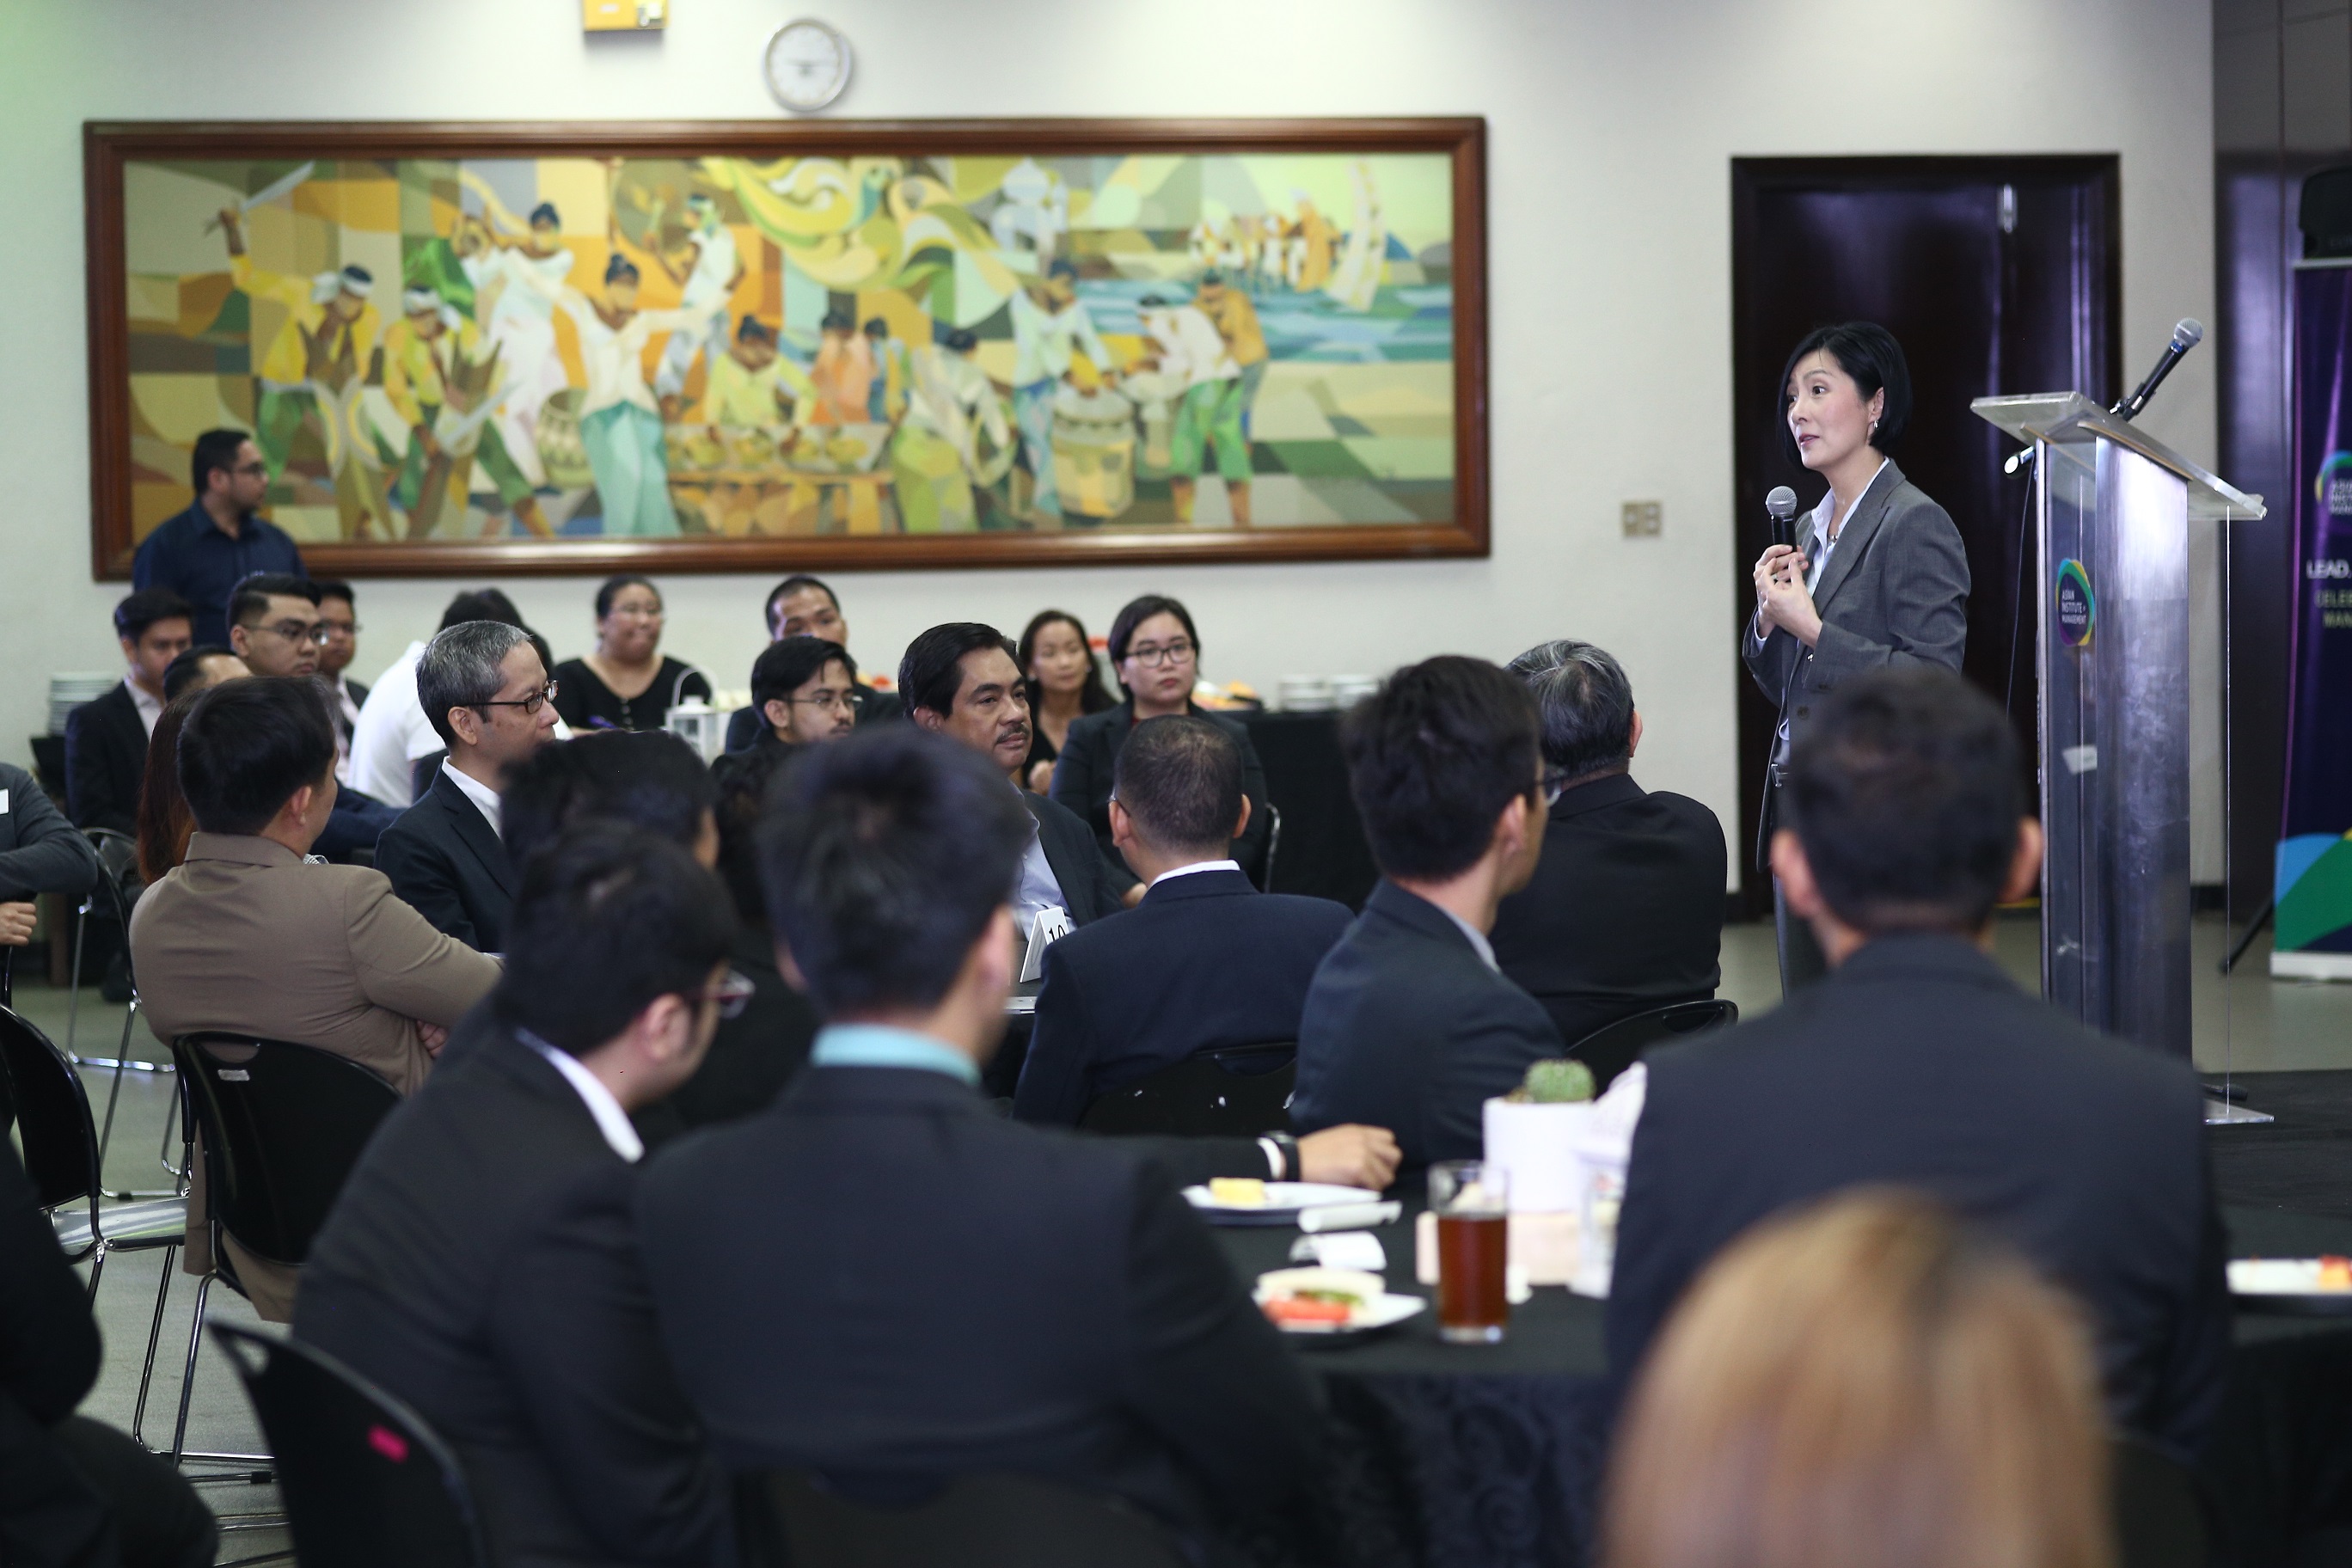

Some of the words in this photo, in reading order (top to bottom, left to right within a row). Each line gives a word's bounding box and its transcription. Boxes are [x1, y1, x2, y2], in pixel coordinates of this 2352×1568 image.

[2061, 590, 2075, 600] ASIAN
[2061, 602, 2082, 614] INSTITUTE
[2061, 614, 2086, 625] MANAGEMENT
